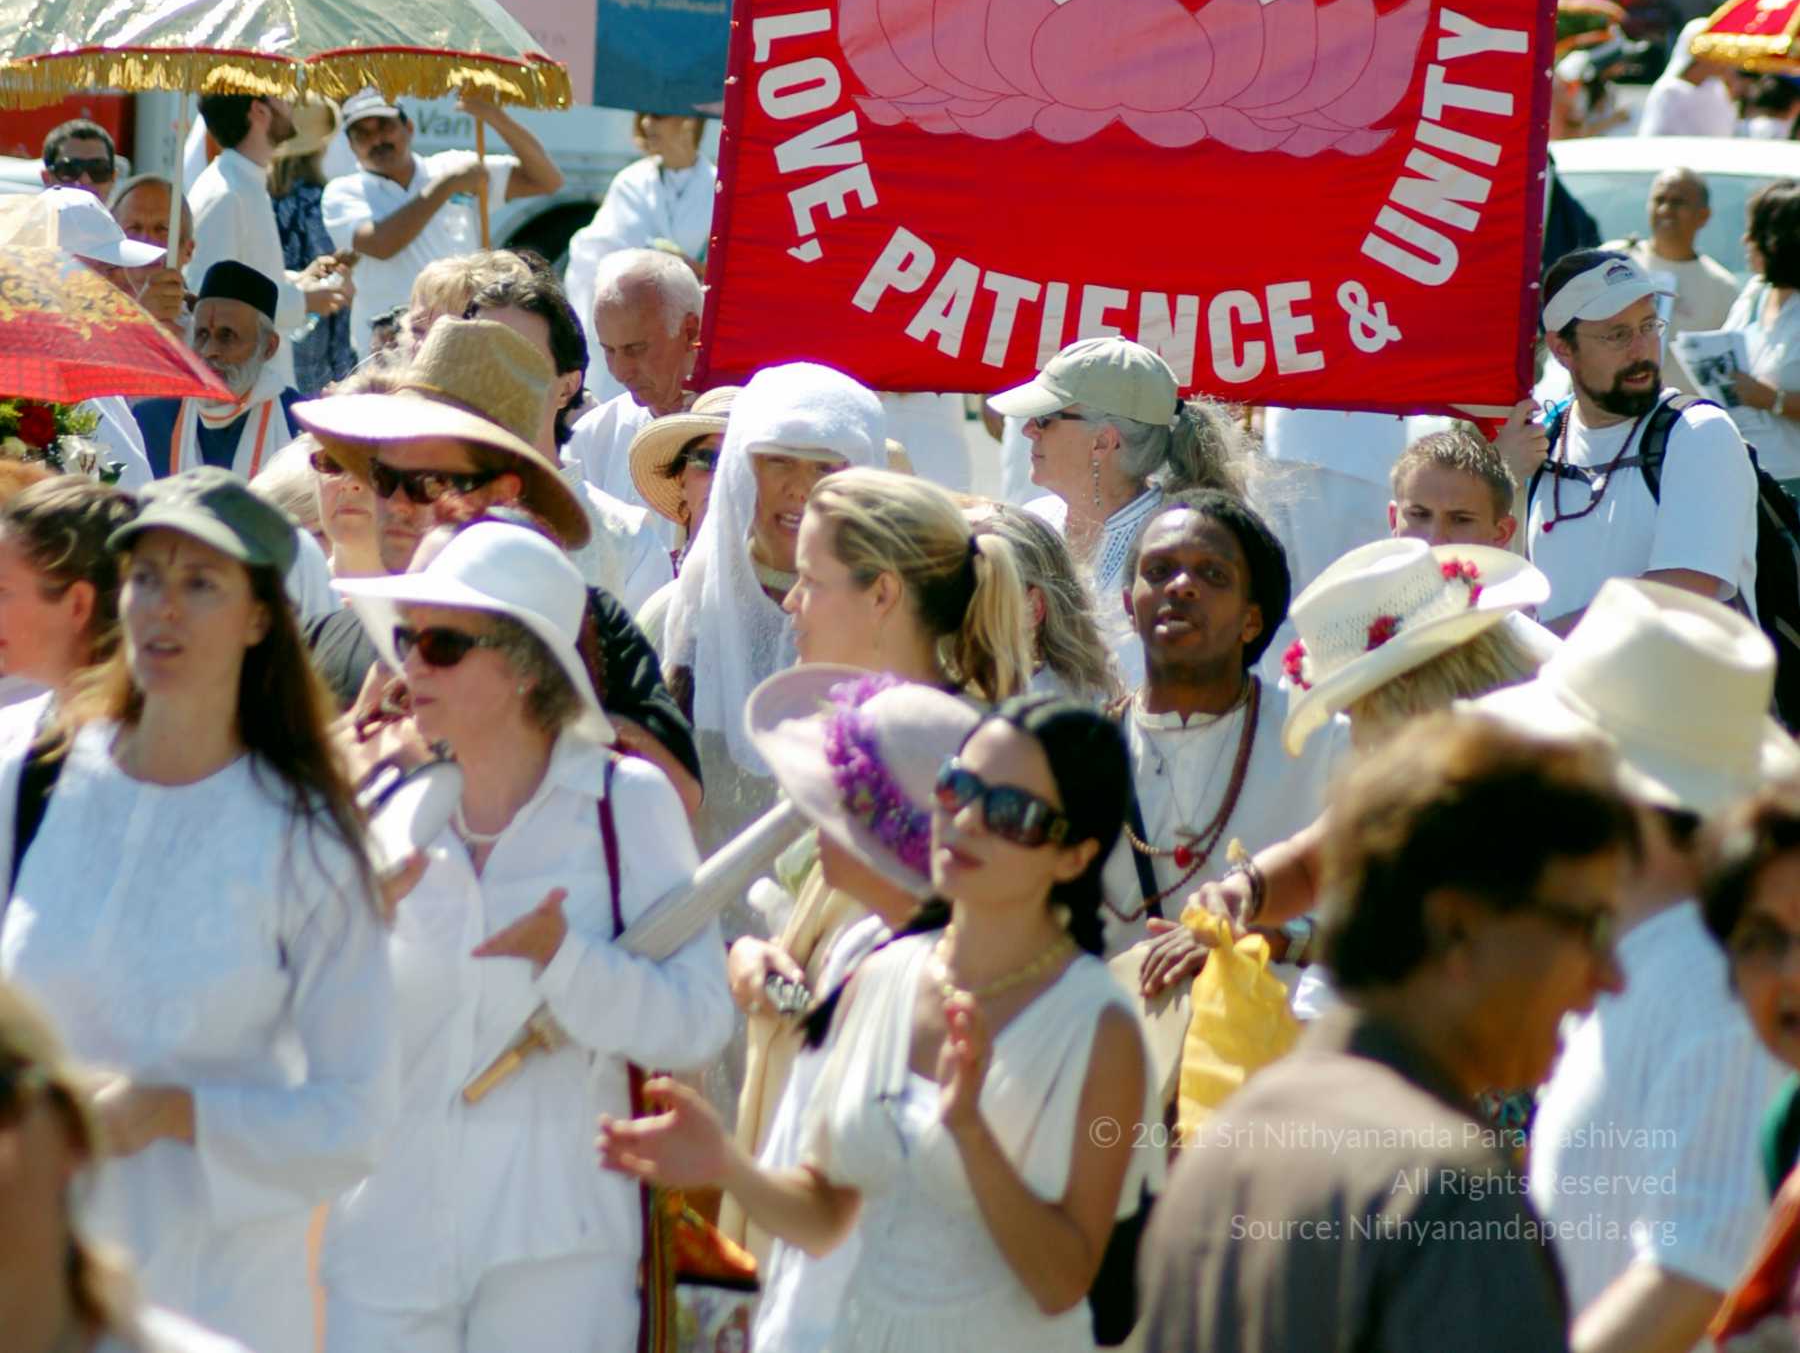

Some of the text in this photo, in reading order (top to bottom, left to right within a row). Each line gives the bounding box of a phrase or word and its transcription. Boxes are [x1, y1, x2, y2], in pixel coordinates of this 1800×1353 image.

[417, 104, 473, 137] Van
[752, 6, 1529, 387] LOVE, PATIENCE & UNITY
